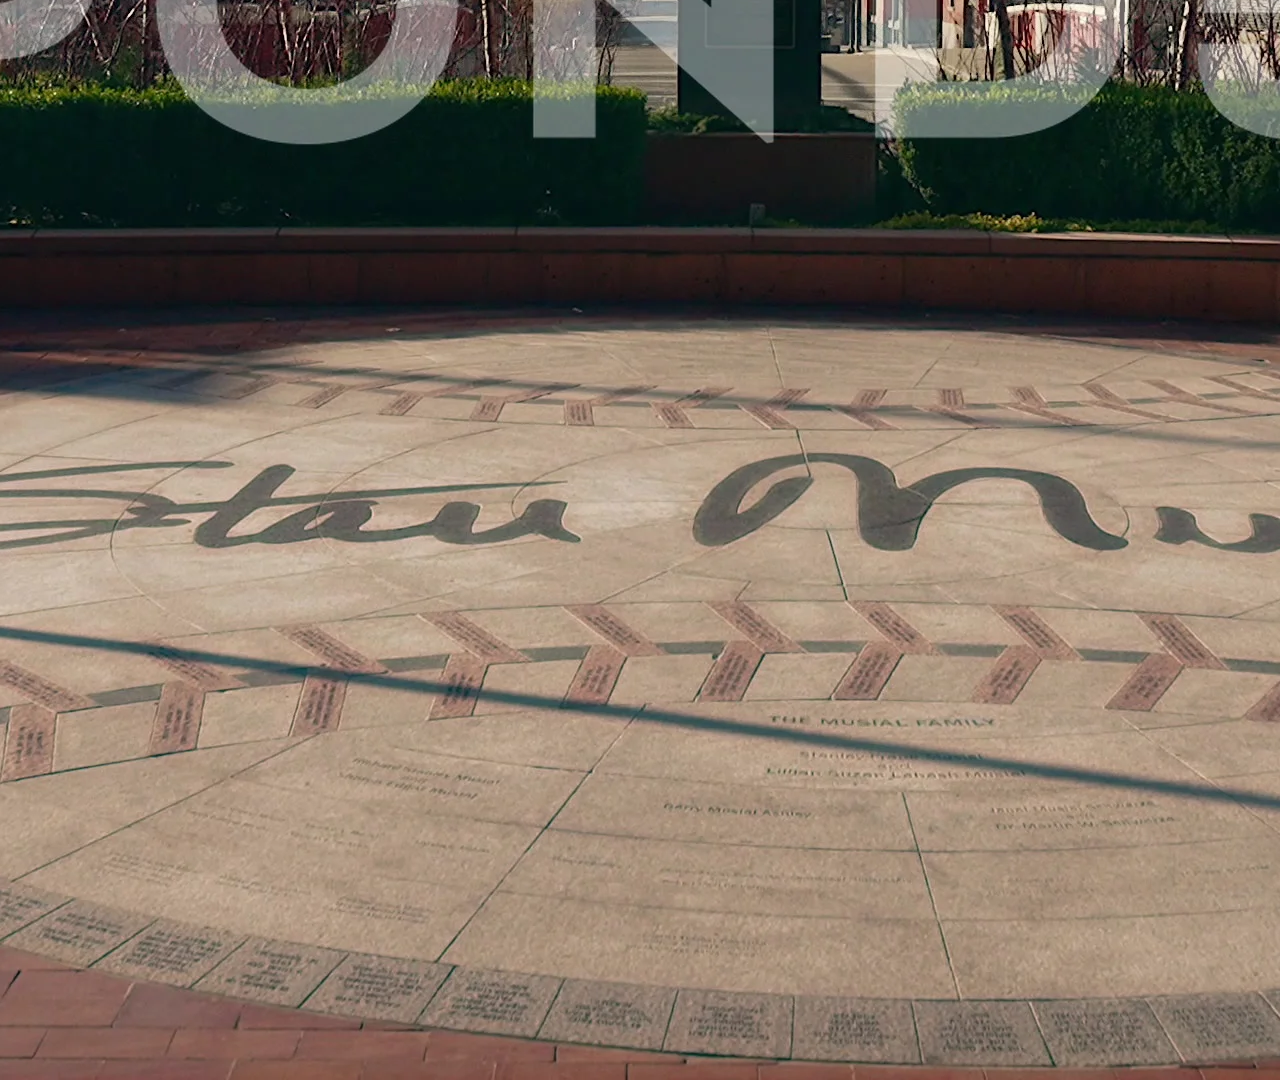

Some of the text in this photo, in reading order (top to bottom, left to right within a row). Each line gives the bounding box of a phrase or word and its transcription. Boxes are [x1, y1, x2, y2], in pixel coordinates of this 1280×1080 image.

[769, 715, 995, 728] THE MUSIAL FAMILY
